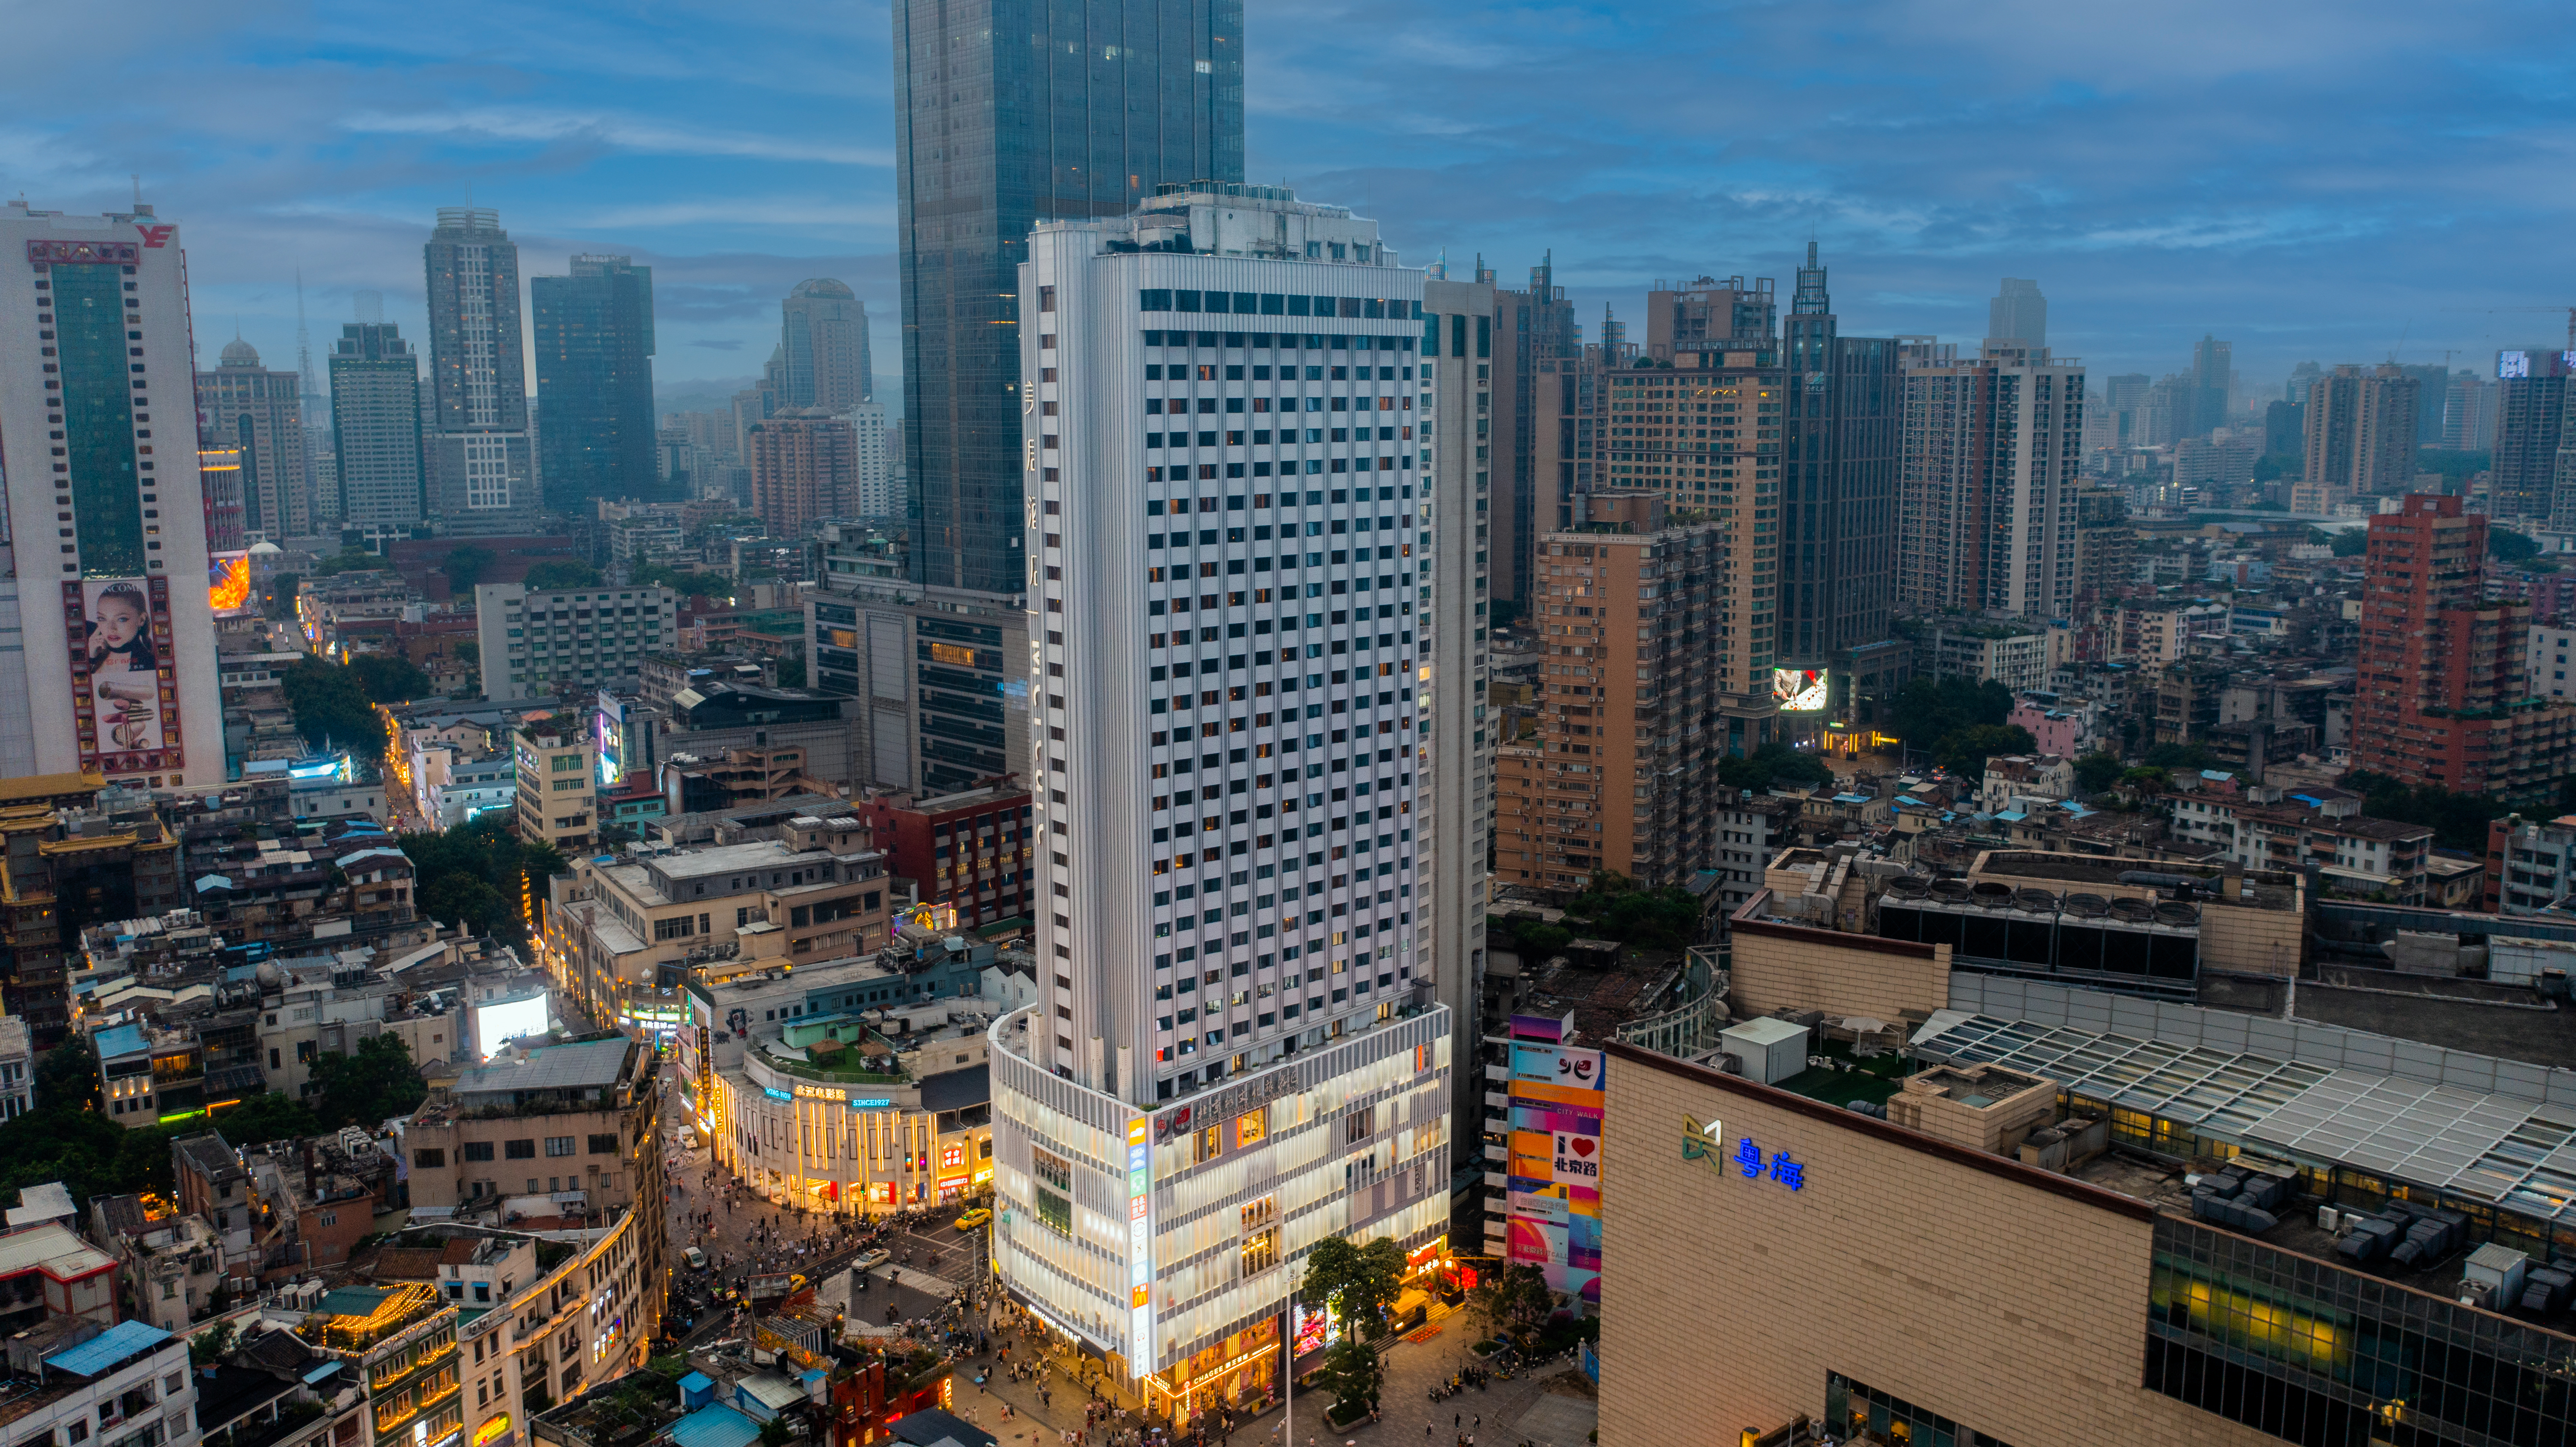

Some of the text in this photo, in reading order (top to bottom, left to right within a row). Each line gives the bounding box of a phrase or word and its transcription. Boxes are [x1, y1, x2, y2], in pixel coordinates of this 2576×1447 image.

[765, 1087, 779, 1097] WING
[795, 1085, 846, 1100] 永汉电影院
[1197, 1115, 1217, 1127] BEIJING
[1218, 1110, 1233, 1119] ROAD
[1234, 1098, 1261, 1113] CULTURAL
[1262, 1090, 1285, 1103] TOURISM
[1577, 1111, 1598, 1119] WALK
[1558, 1135, 1565, 1154] I
[1554, 1157, 1597, 1177] 北京路
[1734, 1138, 1803, 1191] 粤海
[940, 1177, 968, 1187] 中国回力
[1154, 1375, 1171, 1389] CHAGEE
[1193, 1365, 1223, 1384] CHAGEE
